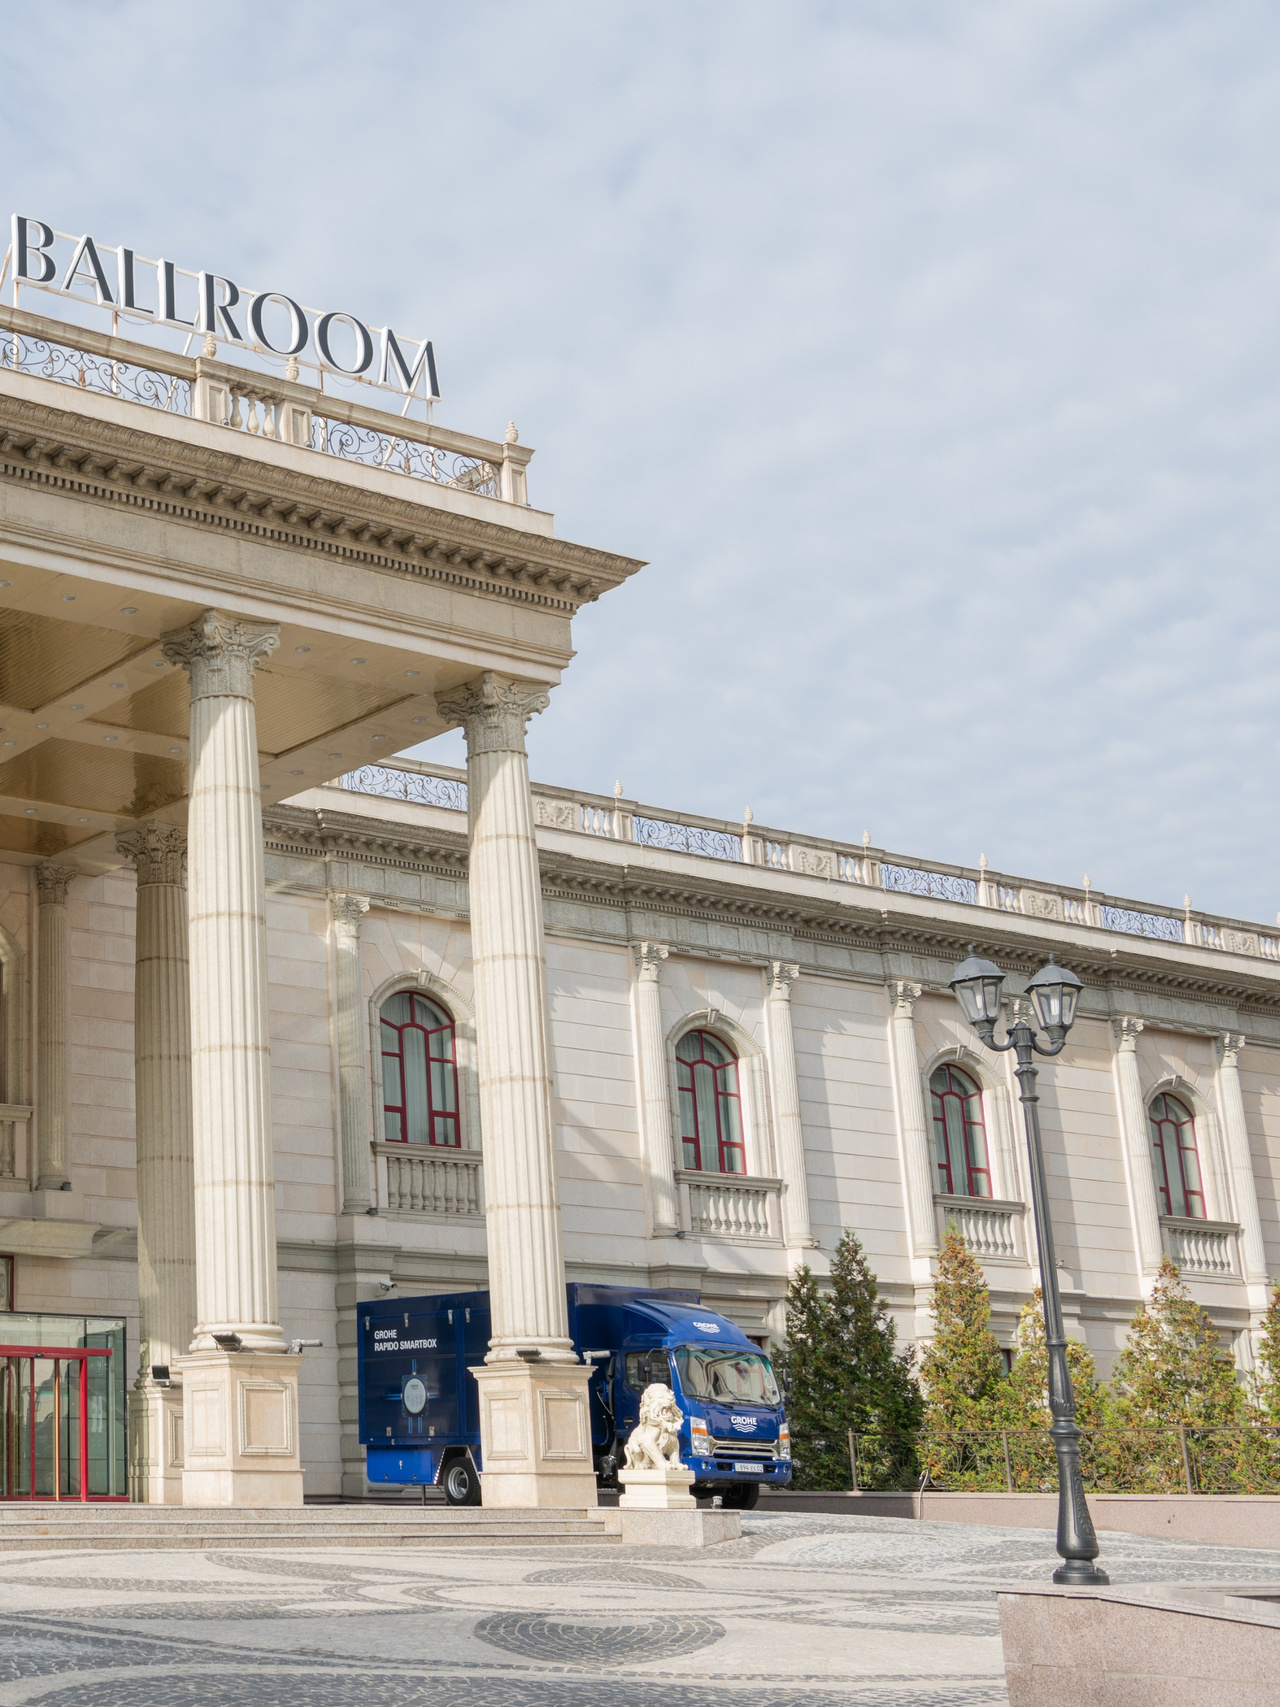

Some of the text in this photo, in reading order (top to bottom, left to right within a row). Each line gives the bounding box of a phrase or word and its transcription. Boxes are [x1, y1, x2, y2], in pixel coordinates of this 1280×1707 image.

[11, 213, 442, 402] BALLROOM
[692, 1321, 720, 1329] GROHE
[374, 1329, 398, 1340] GROHE
[374, 1338, 437, 1352] RAPIDO SMARTBOX
[731, 1415, 758, 1425] GROHE
